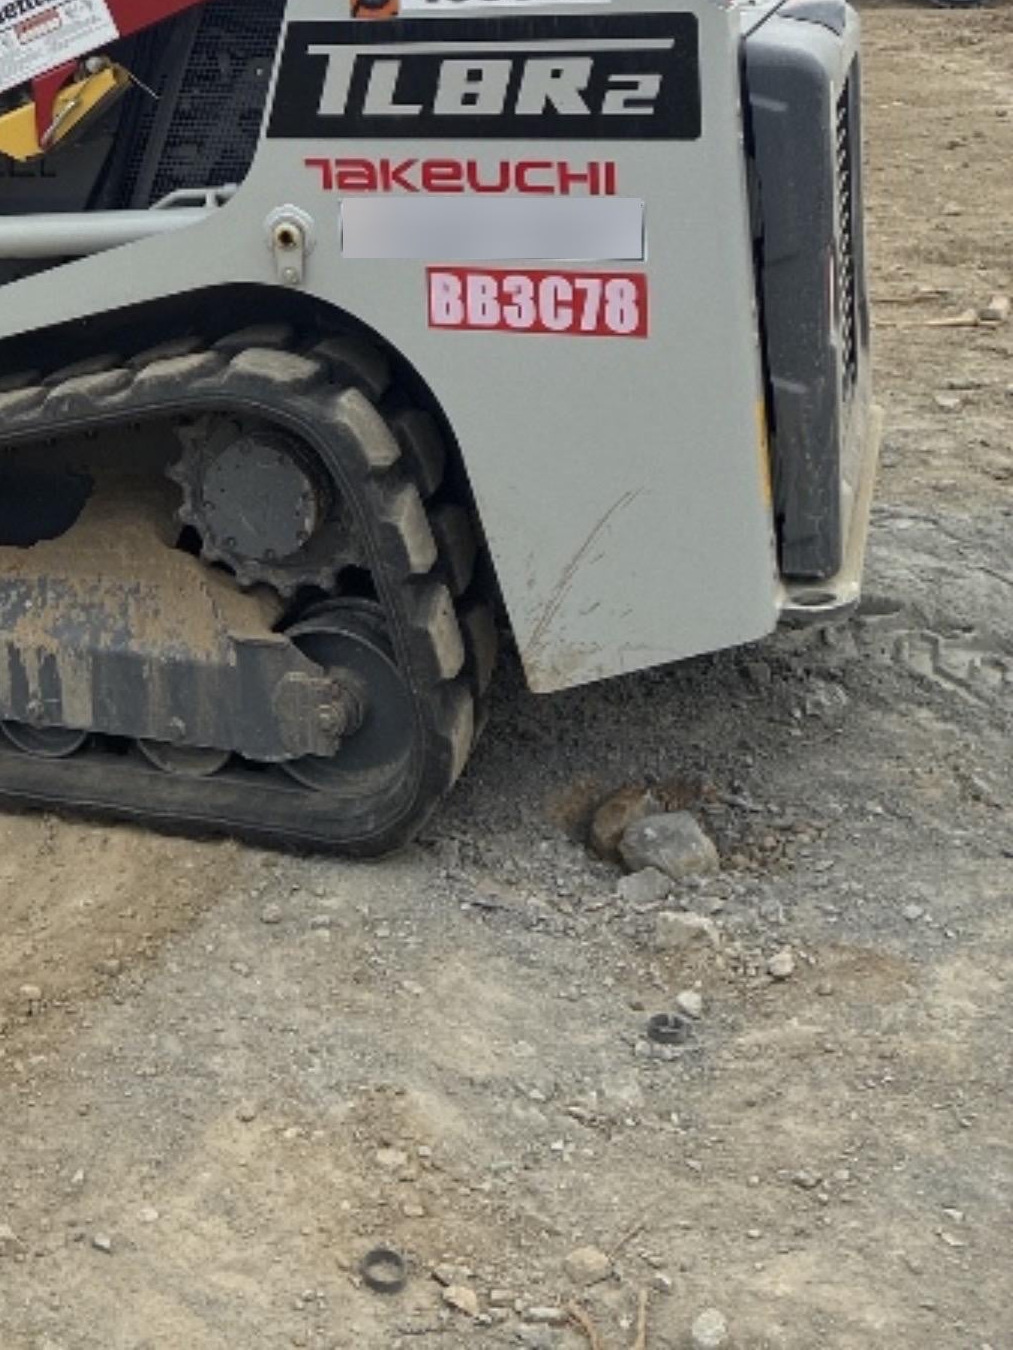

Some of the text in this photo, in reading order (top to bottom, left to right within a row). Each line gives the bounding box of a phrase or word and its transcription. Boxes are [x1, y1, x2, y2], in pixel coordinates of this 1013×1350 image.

[307, 37, 675, 116] TL8R2
[304, 158, 617, 195] TAKEUCHI
[429, 272, 640, 334] BB3C78
